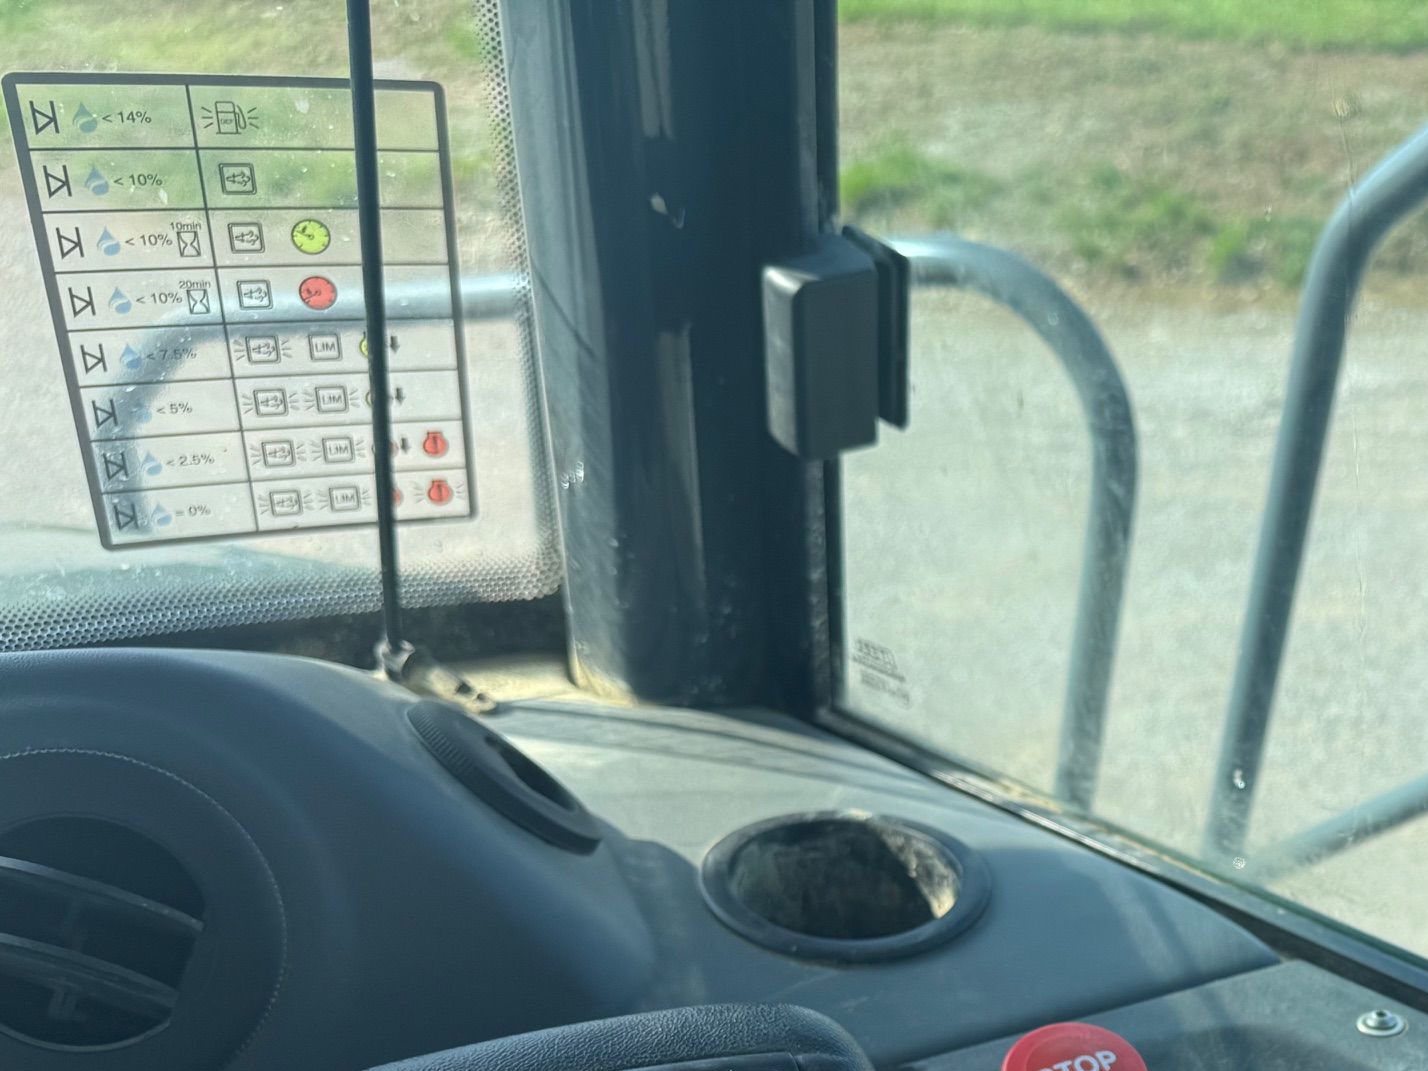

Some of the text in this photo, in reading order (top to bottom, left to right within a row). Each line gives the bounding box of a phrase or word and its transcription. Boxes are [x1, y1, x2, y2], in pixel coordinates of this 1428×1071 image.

[118, 111, 152, 124] 14%
[129, 173, 163, 186] 10%
[170, 221, 201, 232] 10min
[141, 234, 173, 247] 10%
[179, 280, 211, 290] 20min
[151, 292, 182, 305] 10%
[314, 341, 336, 353] LIM
[159, 349, 197, 361] 7.5%
[322, 394, 343, 406] LIM
[169, 402, 193, 414] 5%
[328, 444, 350, 456] LIM
[179, 454, 214, 467] 2.5%
[188, 505, 211, 517] 0%
